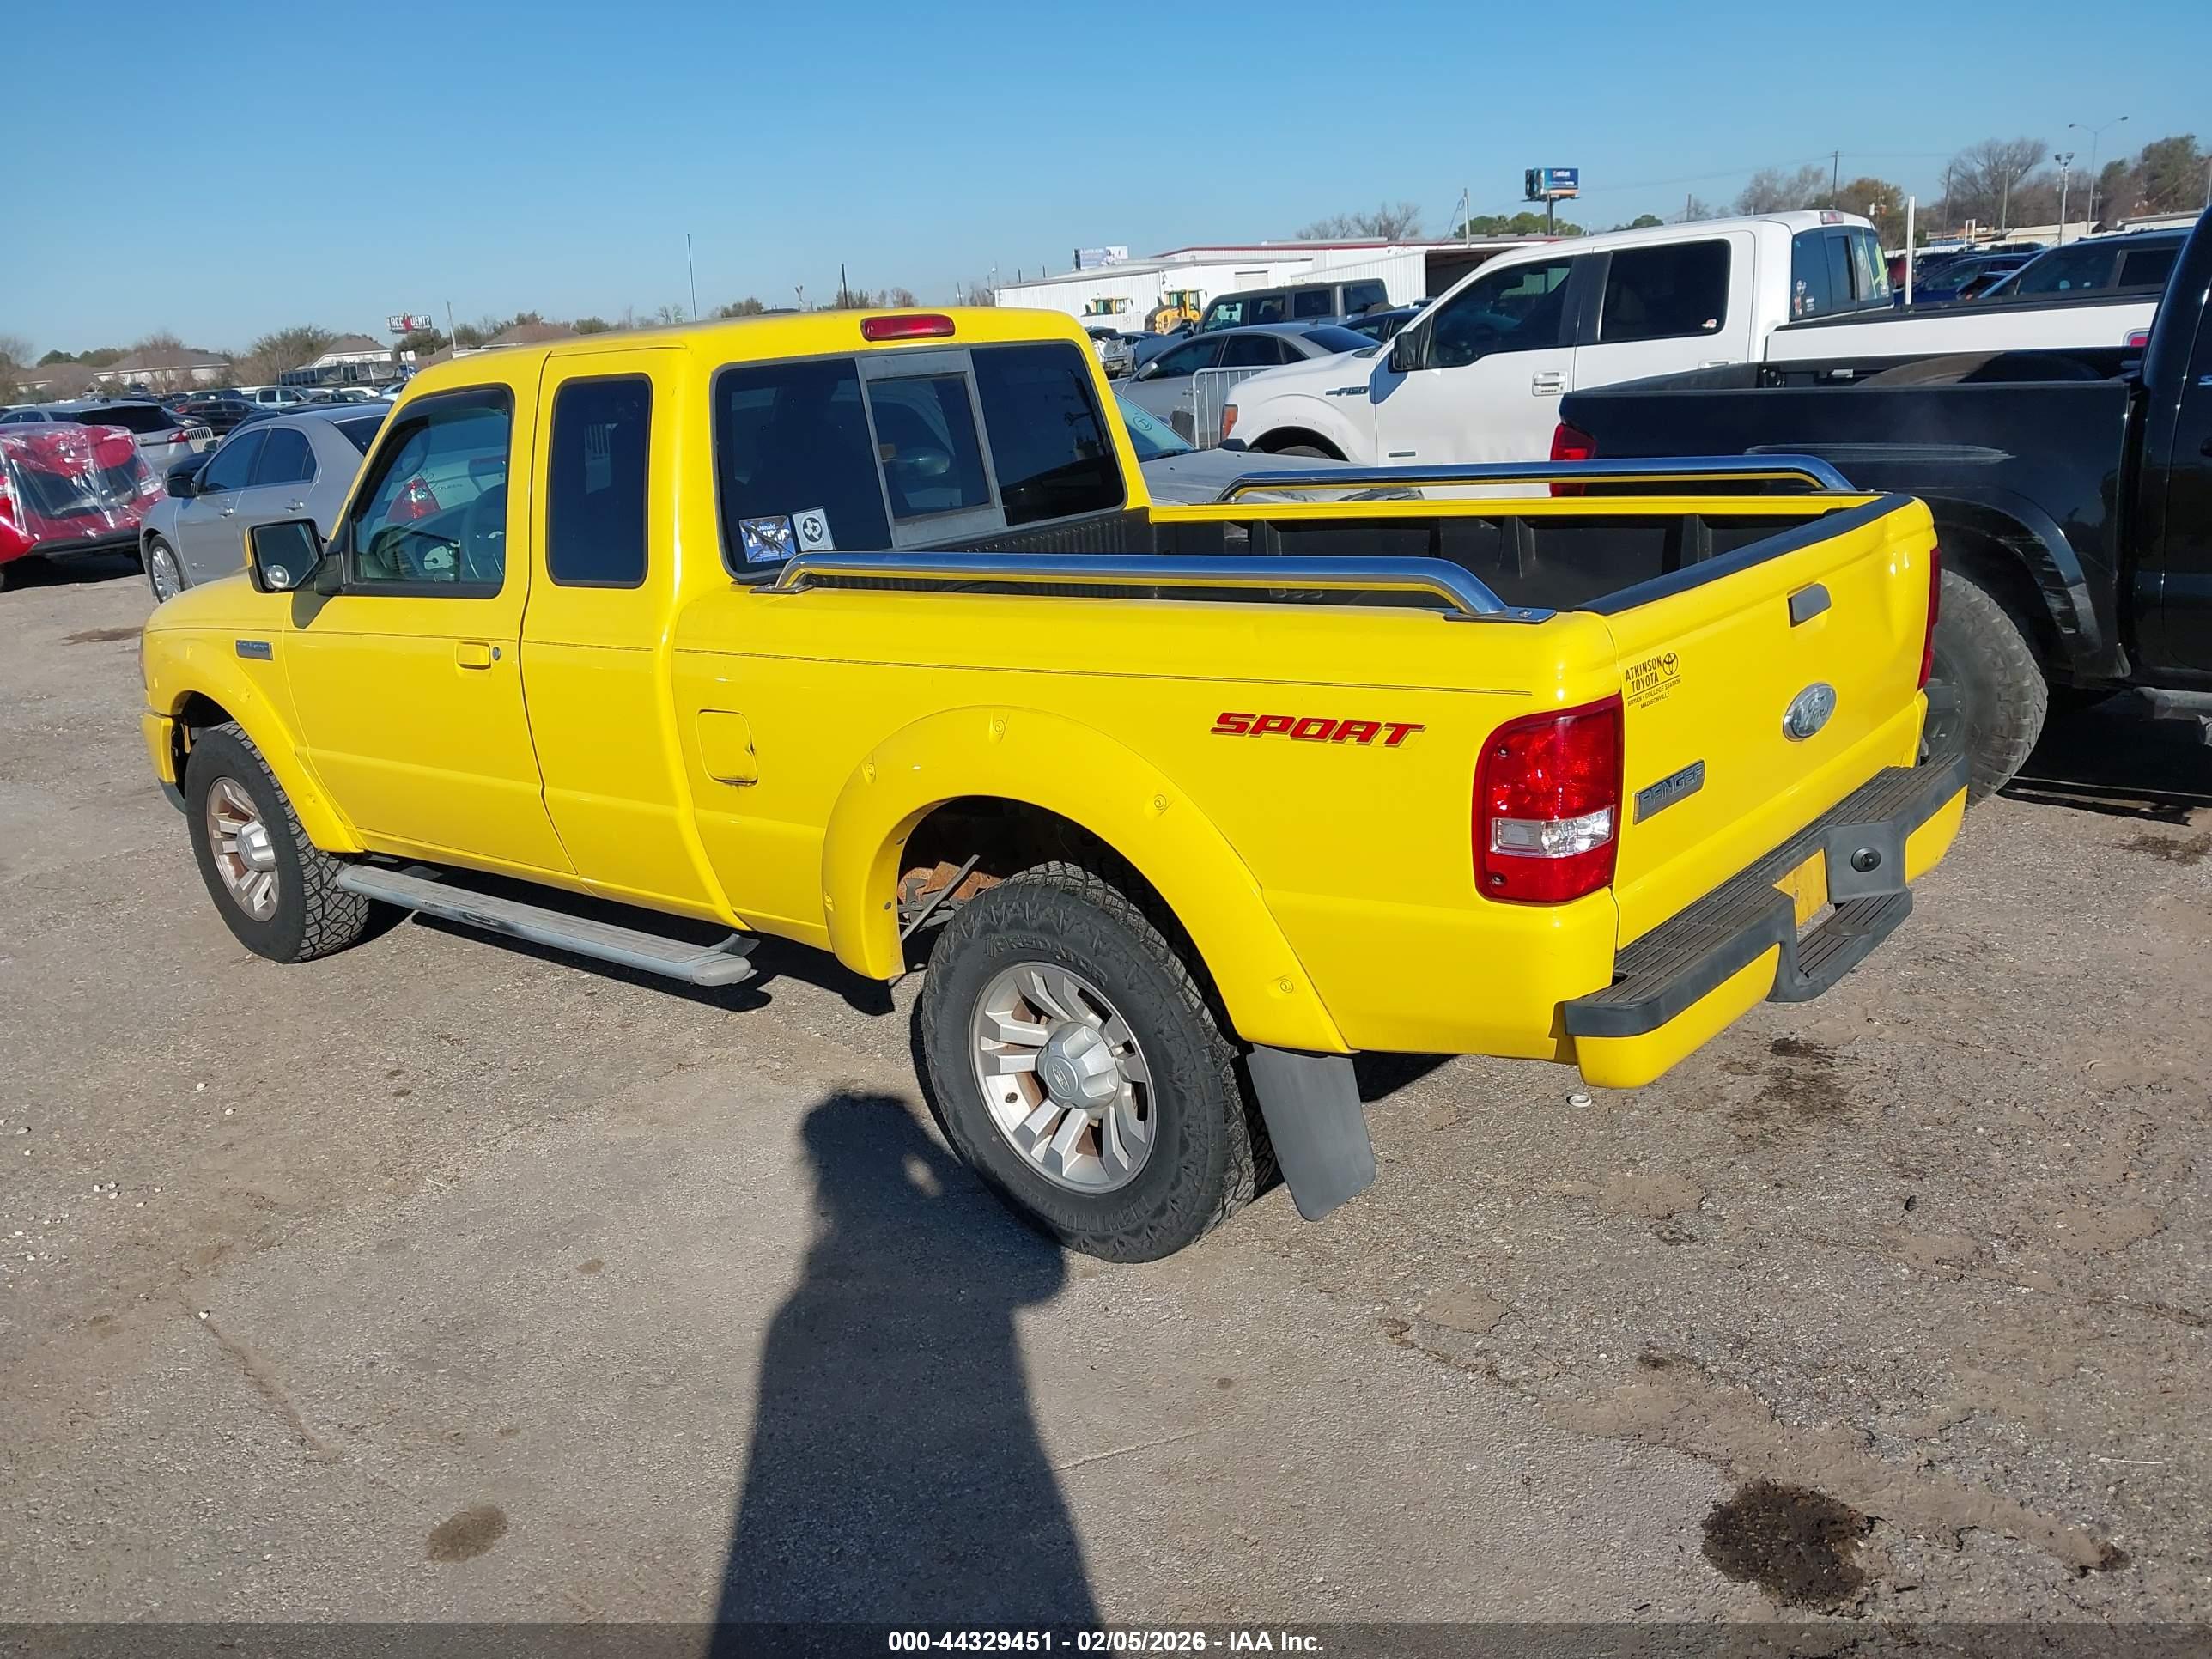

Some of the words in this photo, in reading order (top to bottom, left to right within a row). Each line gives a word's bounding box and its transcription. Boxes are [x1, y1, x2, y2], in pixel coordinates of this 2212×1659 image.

[390, 315, 429, 327] ACCDENT?
[1626, 655, 1662, 683] ATKINSON
[1632, 672, 1659, 694] TOYOTA
[1628, 696, 1642, 707] BRYAN
[1645, 685, 1664, 699] COLLEGE
[1665, 678, 1681, 690] STATION
[1641, 690, 1670, 709] MADISONVILLE
[1211, 713, 1426, 748] SPORT
[1641, 762, 1704, 811] RANGER
